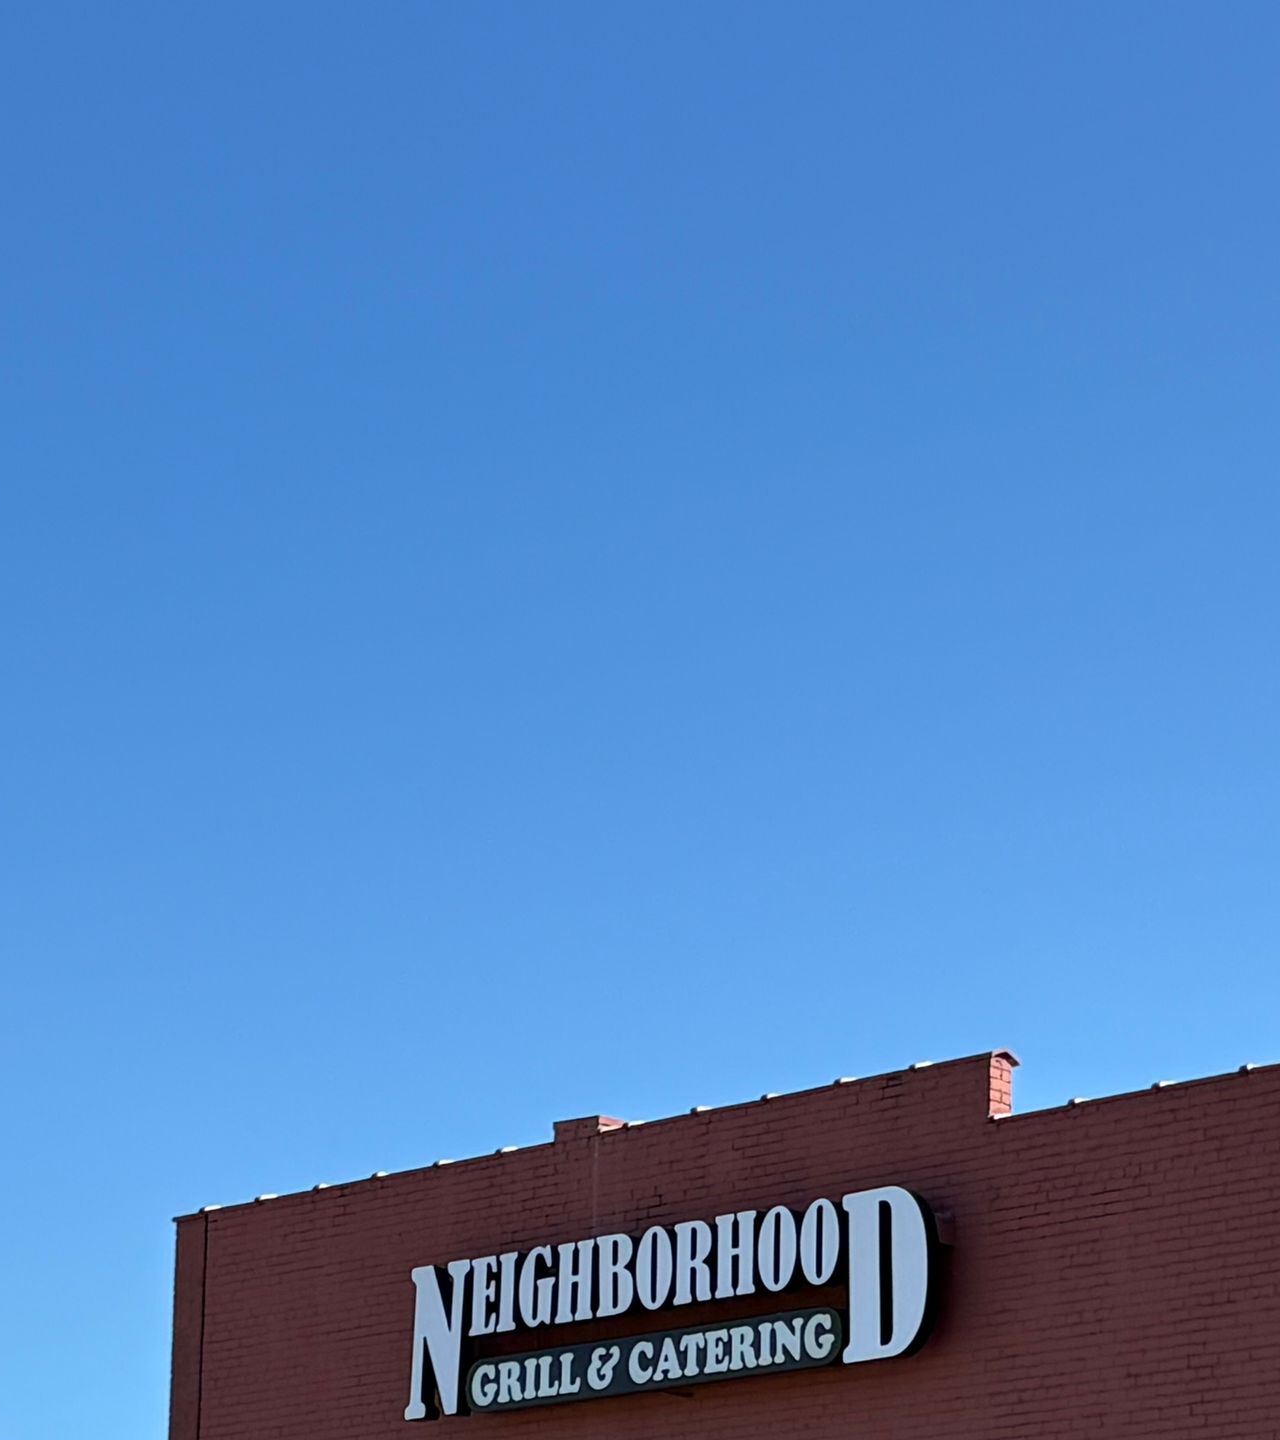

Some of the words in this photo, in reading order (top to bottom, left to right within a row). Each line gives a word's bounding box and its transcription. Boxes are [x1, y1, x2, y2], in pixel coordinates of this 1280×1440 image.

[404, 1186, 928, 1420] NEIGHBORHOOD
[471, 1353, 581, 1407] GRILL
[587, 1345, 620, 1390] &
[628, 1313, 835, 1384] CATERING
